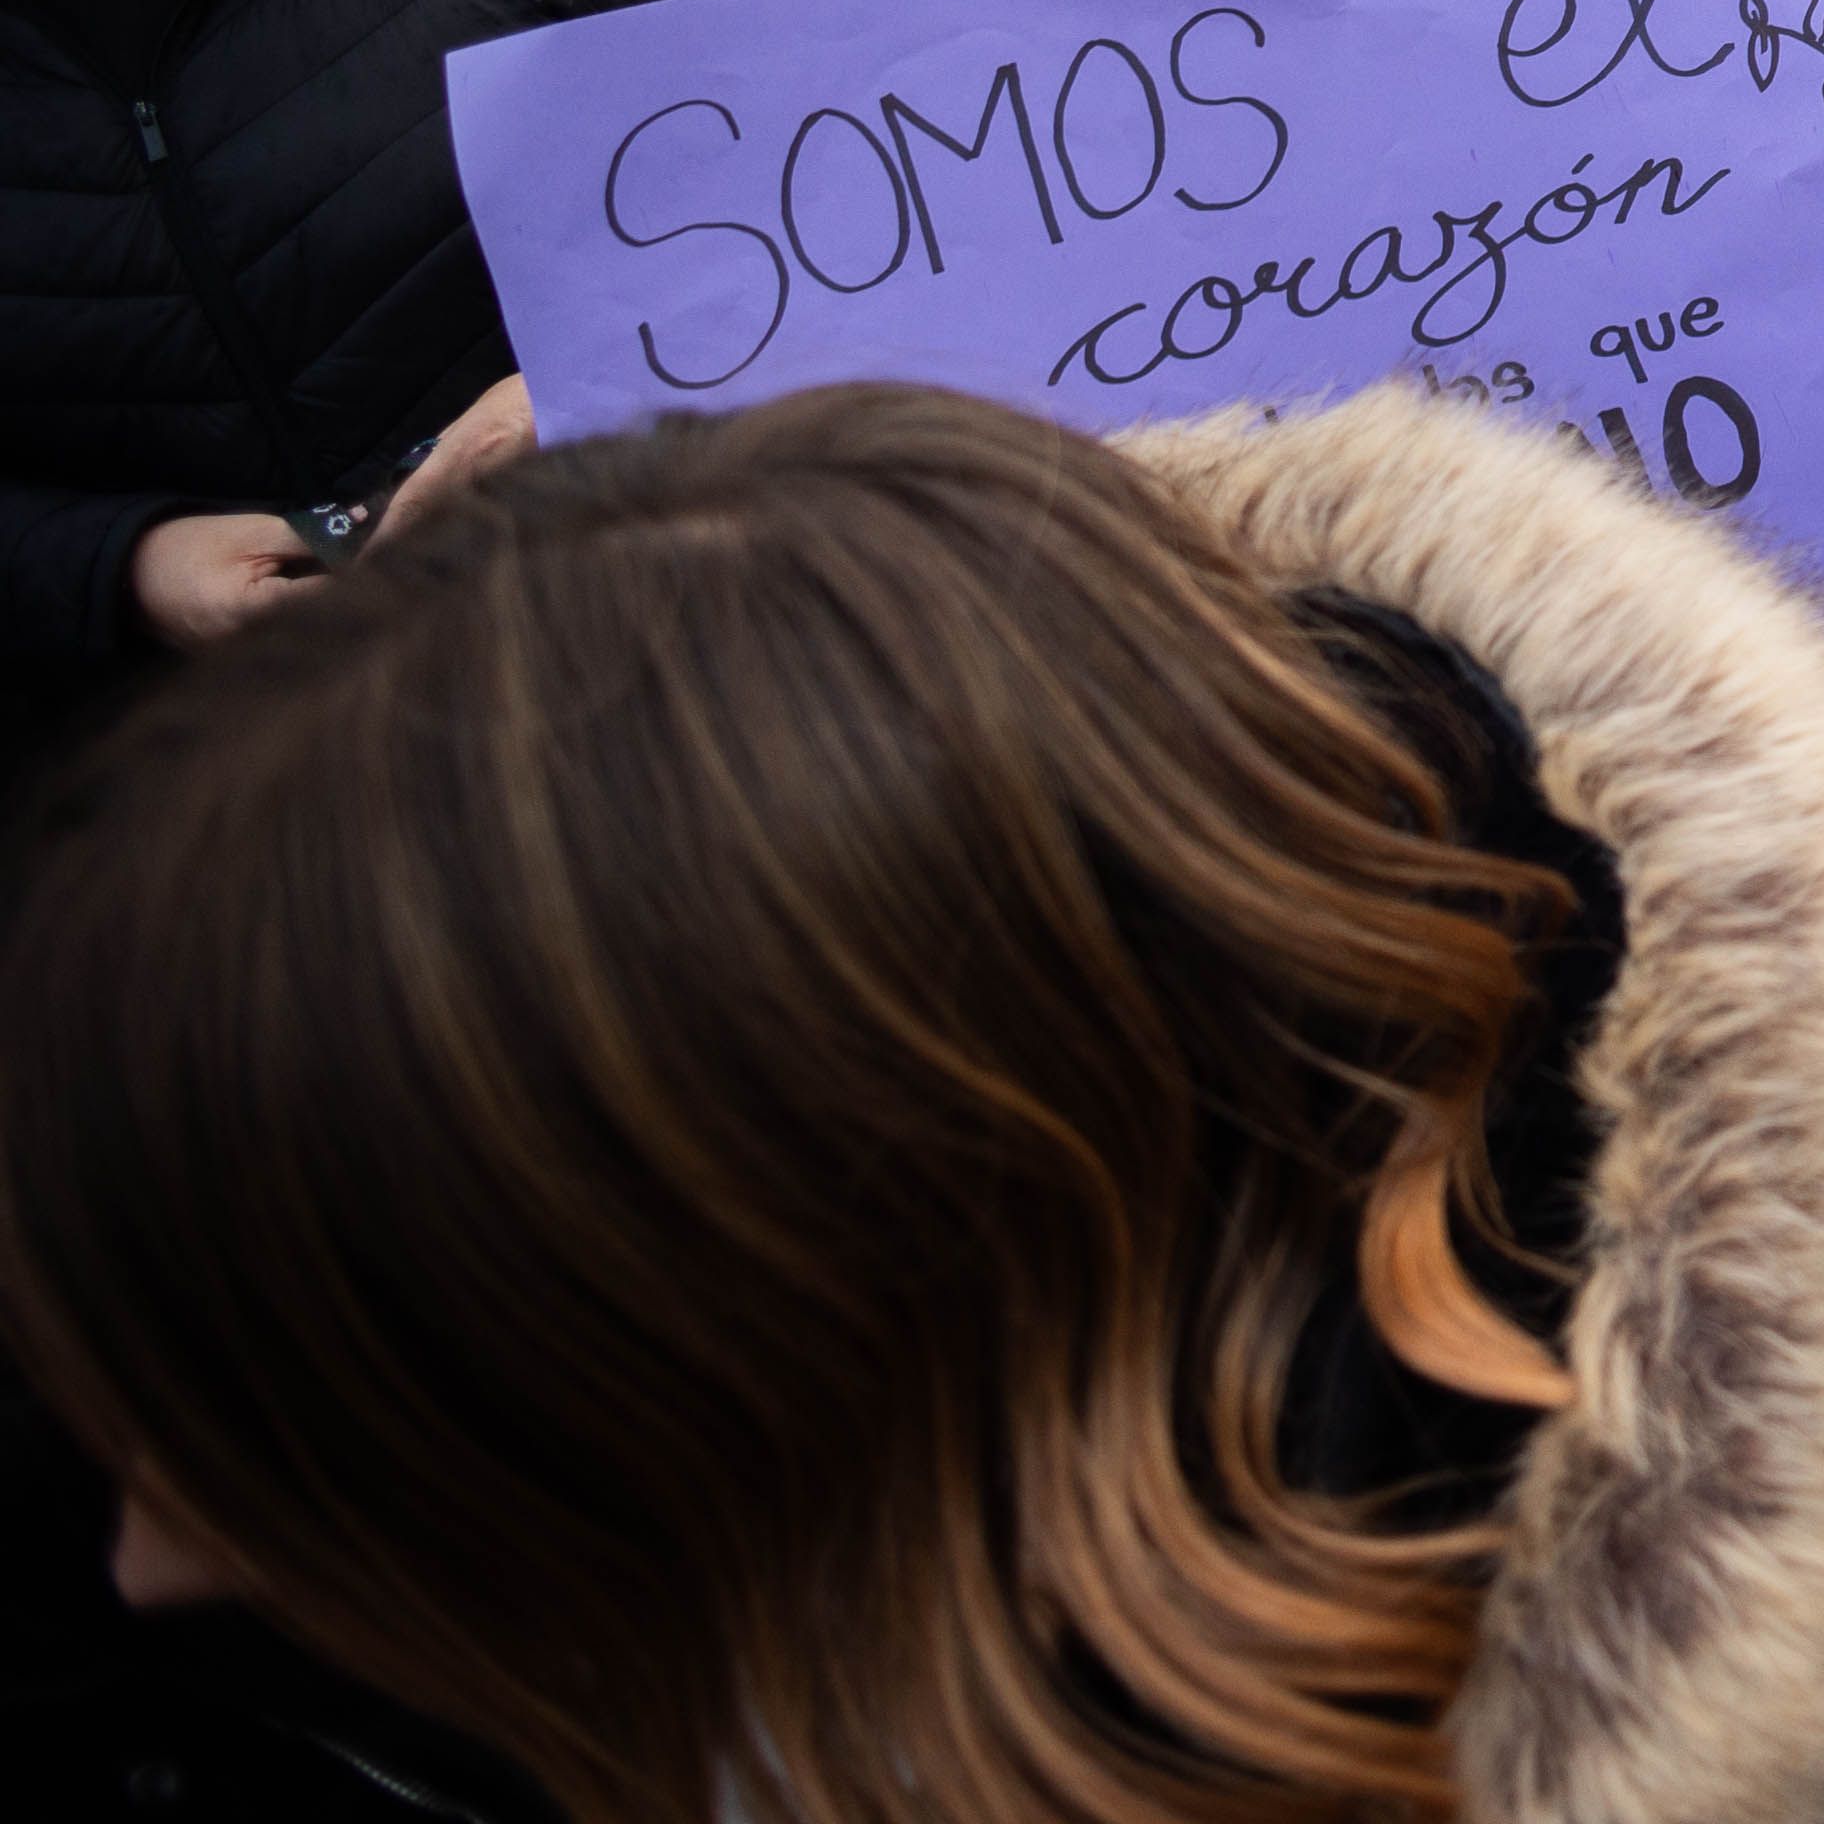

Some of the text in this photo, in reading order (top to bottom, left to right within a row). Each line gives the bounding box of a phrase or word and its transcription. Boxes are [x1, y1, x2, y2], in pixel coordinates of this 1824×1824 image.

[602, 6, 1289, 391] SOMOS
[1046, 153, 1731, 387] corazón
[1590, 296, 1724, 384] que
